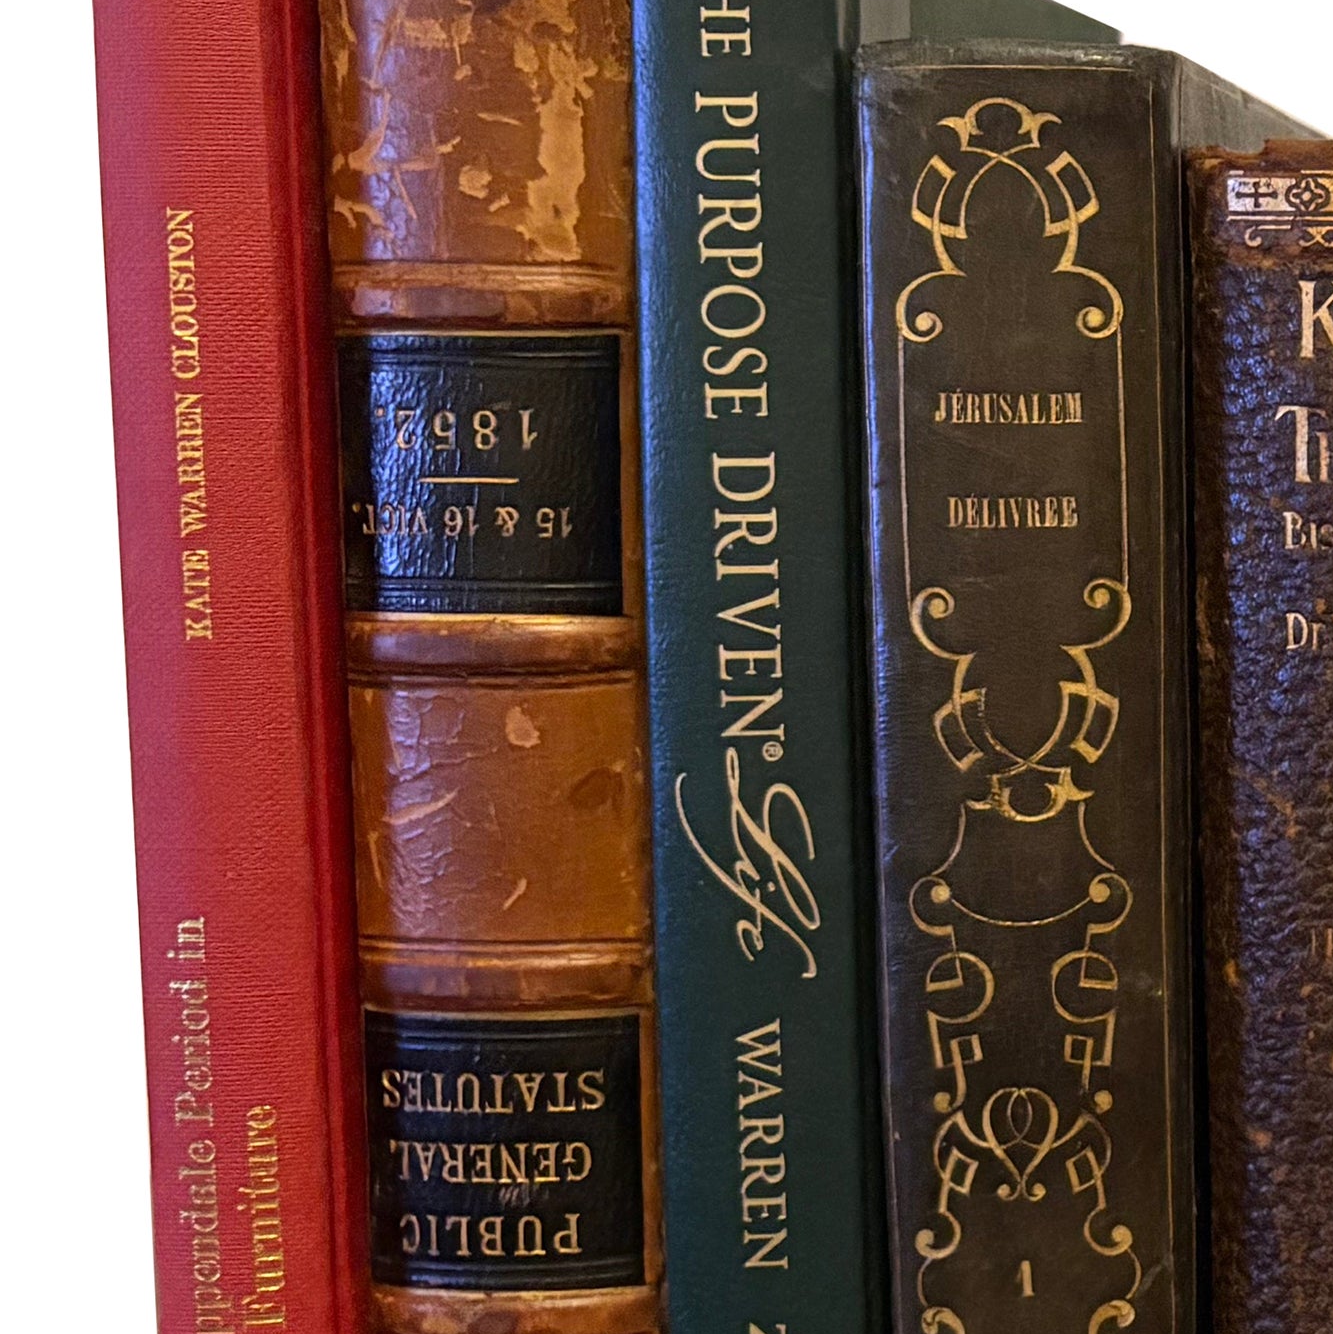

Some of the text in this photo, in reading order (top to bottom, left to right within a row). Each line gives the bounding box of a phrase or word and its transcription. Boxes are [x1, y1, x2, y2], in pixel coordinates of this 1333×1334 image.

[694, 90, 770, 419] PURPOSE
[166, 207, 212, 640] KATE WARREN CLOUSTON
[373, 406, 539, 451] 1852.
[934, 388, 1084, 425] JÉRUSALEM
[351, 502, 573, 539] 15 & 16 VICT.
[1286, 612, 1325, 651] Dr
[675, 746, 821, 979] Life
[167, 917, 205, 963] in
[169, 979, 214, 1127] Period
[380, 1068, 607, 1113] STATUTES
[388, 1139, 593, 1184] GENERAL
[735, 1018, 789, 1270] WARREN
[239, 1104, 286, 1329] Furniture
[398, 1211, 584, 1257] PUBLIC
